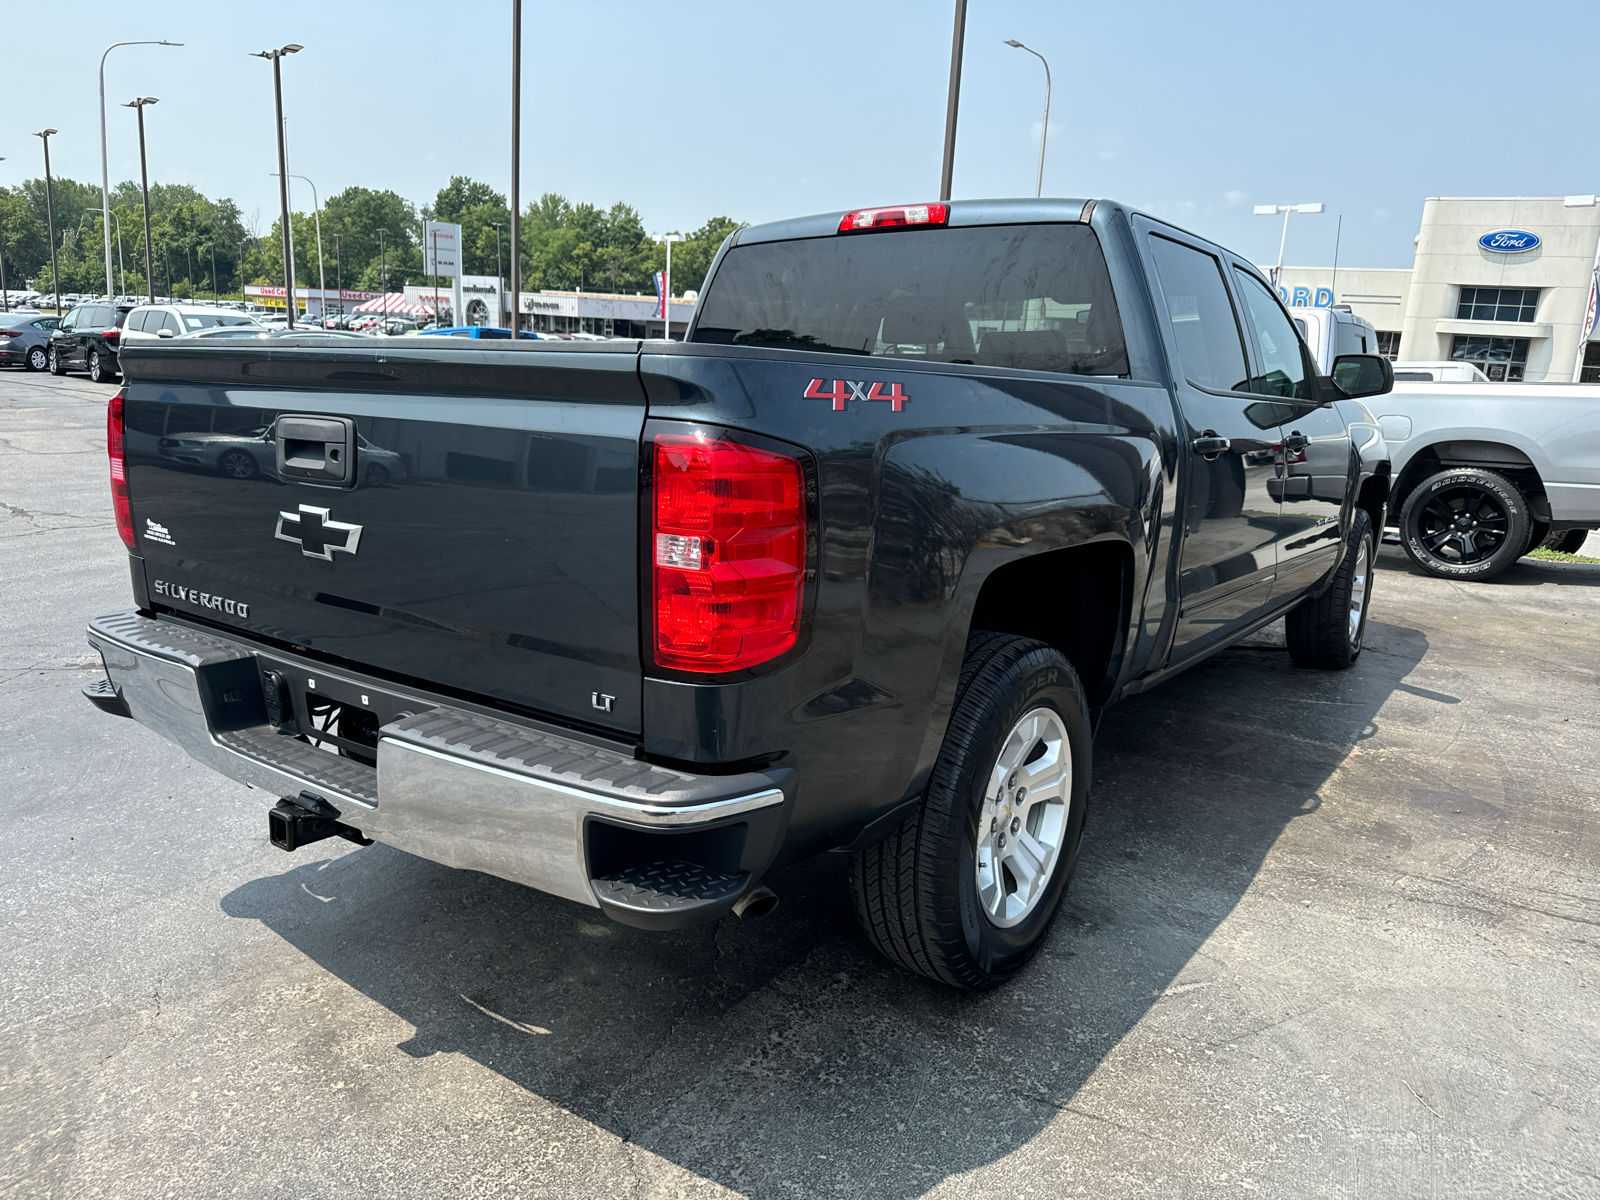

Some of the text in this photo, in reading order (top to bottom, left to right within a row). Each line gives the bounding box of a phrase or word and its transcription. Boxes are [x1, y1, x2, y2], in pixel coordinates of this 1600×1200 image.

[1490, 233, 1527, 247] Ford
[260, 287, 275, 295] Used
[341, 291, 362, 299] Used
[1279, 286, 1333, 308] ORD
[154, 579, 250, 618] SILVERADO
[592, 691, 616, 712] LT
